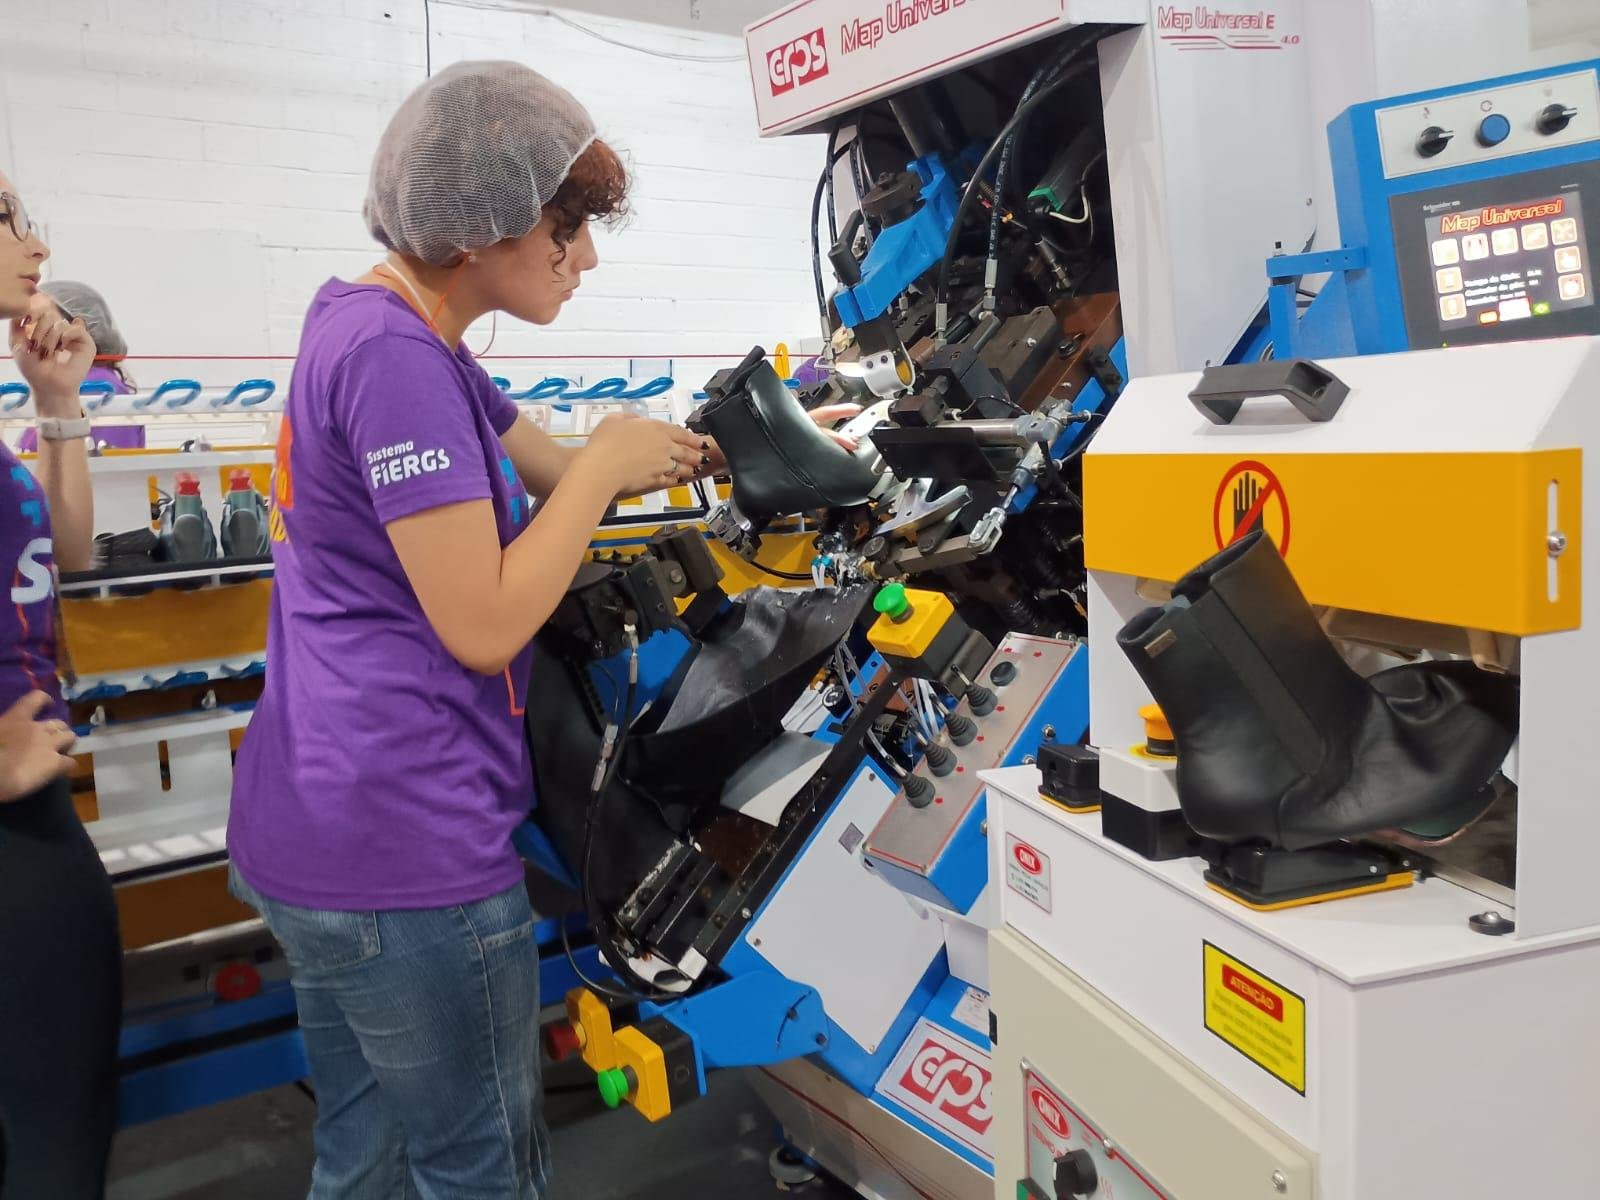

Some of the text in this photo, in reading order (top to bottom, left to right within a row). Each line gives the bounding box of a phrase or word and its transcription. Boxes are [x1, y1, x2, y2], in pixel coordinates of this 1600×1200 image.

[841, 0, 974, 56] Map Univer
[1158, 6, 1276, 32] Map Universal E
[1441, 214, 1481, 234] Map
[1482, 199, 1564, 226] Universal
[366, 440, 414, 465] Sistema
